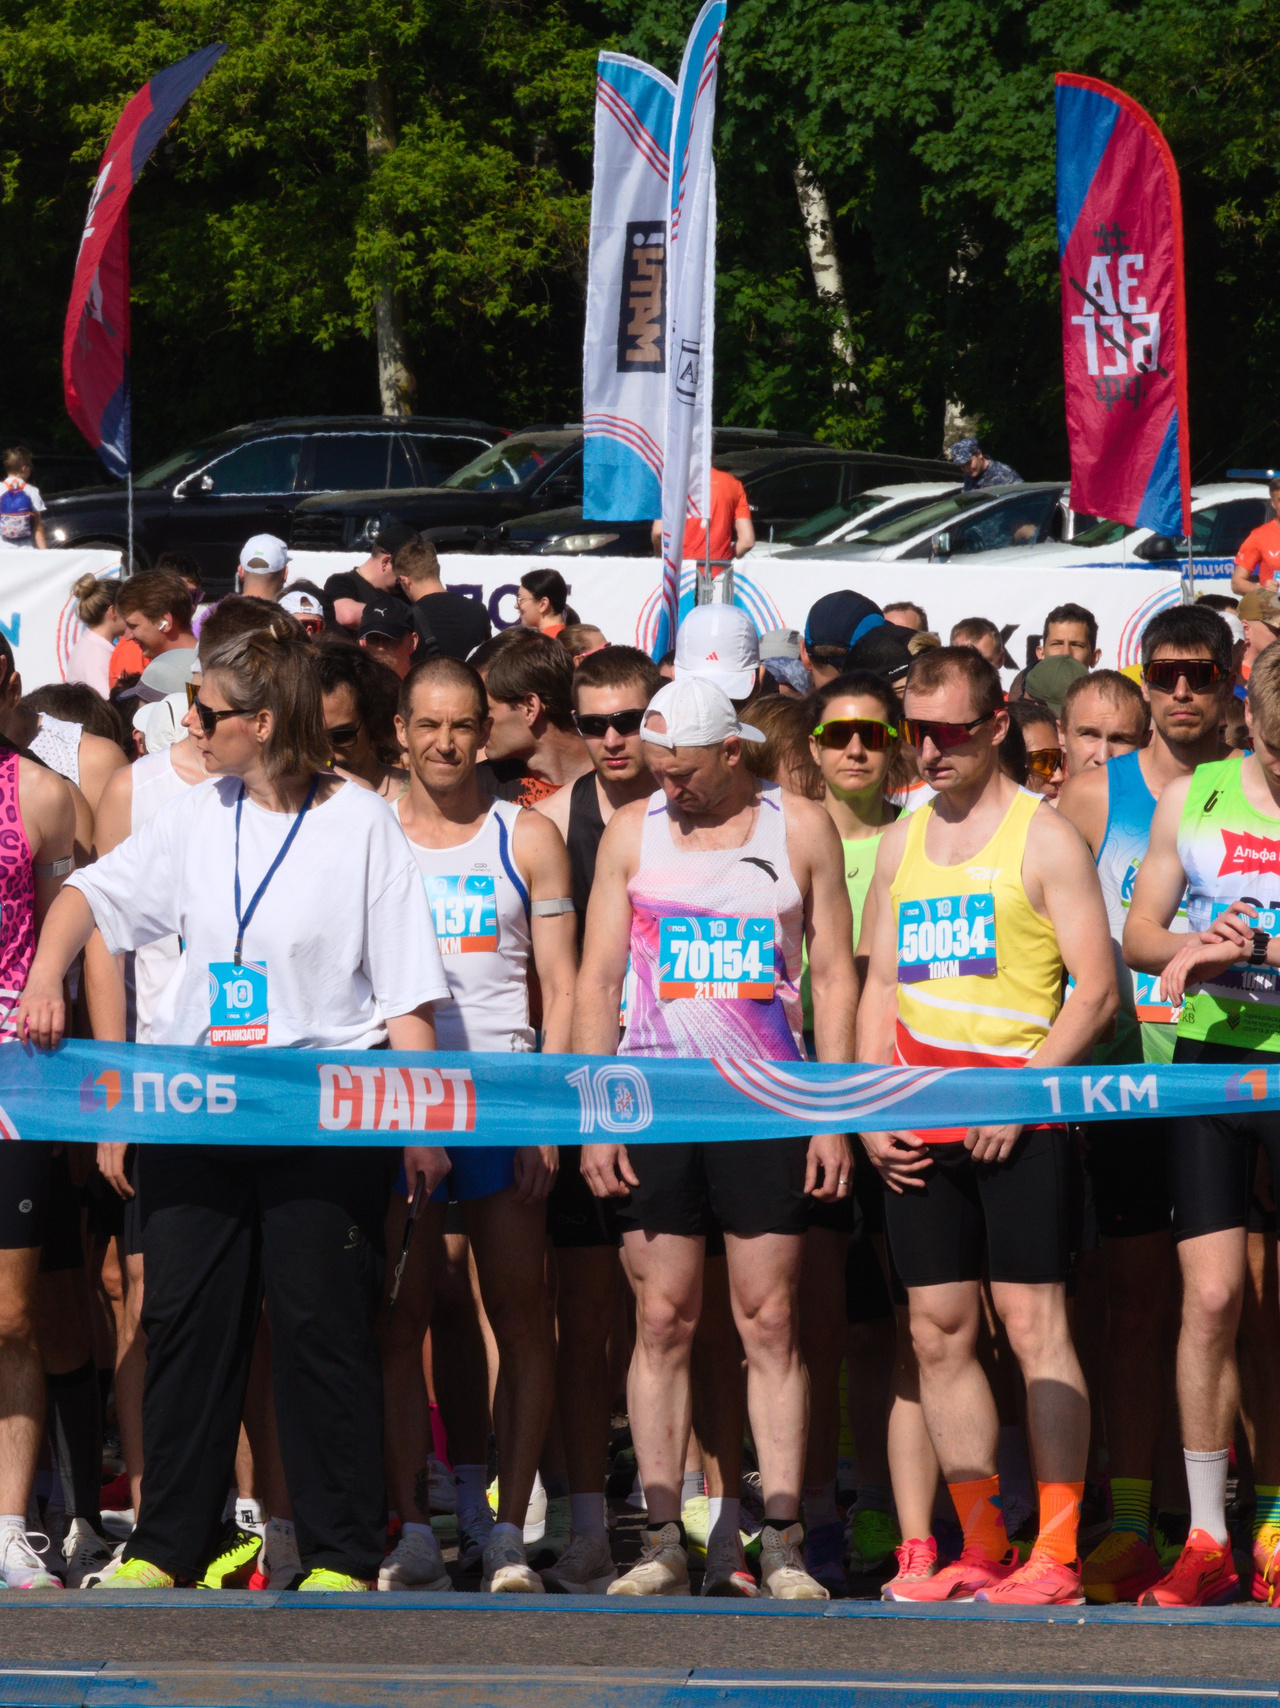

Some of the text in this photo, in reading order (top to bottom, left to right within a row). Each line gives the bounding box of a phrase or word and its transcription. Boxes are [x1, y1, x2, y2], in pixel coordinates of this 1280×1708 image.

[1233, 845, 1277, 863] Альфа
[935, 899, 952, 917] 10
[708, 920, 727, 938] 10
[902, 916, 989, 963] 50034
[670, 940, 763, 979] 70154
[222, 979, 253, 1009] 10
[212, 1028, 266, 1042] ОРГАНИЗАТОР
[133, 1072, 237, 1114] ПСБ
[319, 1064, 472, 1132] СТАРТ
[564, 1064, 654, 1134] 10
[1042, 1076, 1062, 1114] 1
